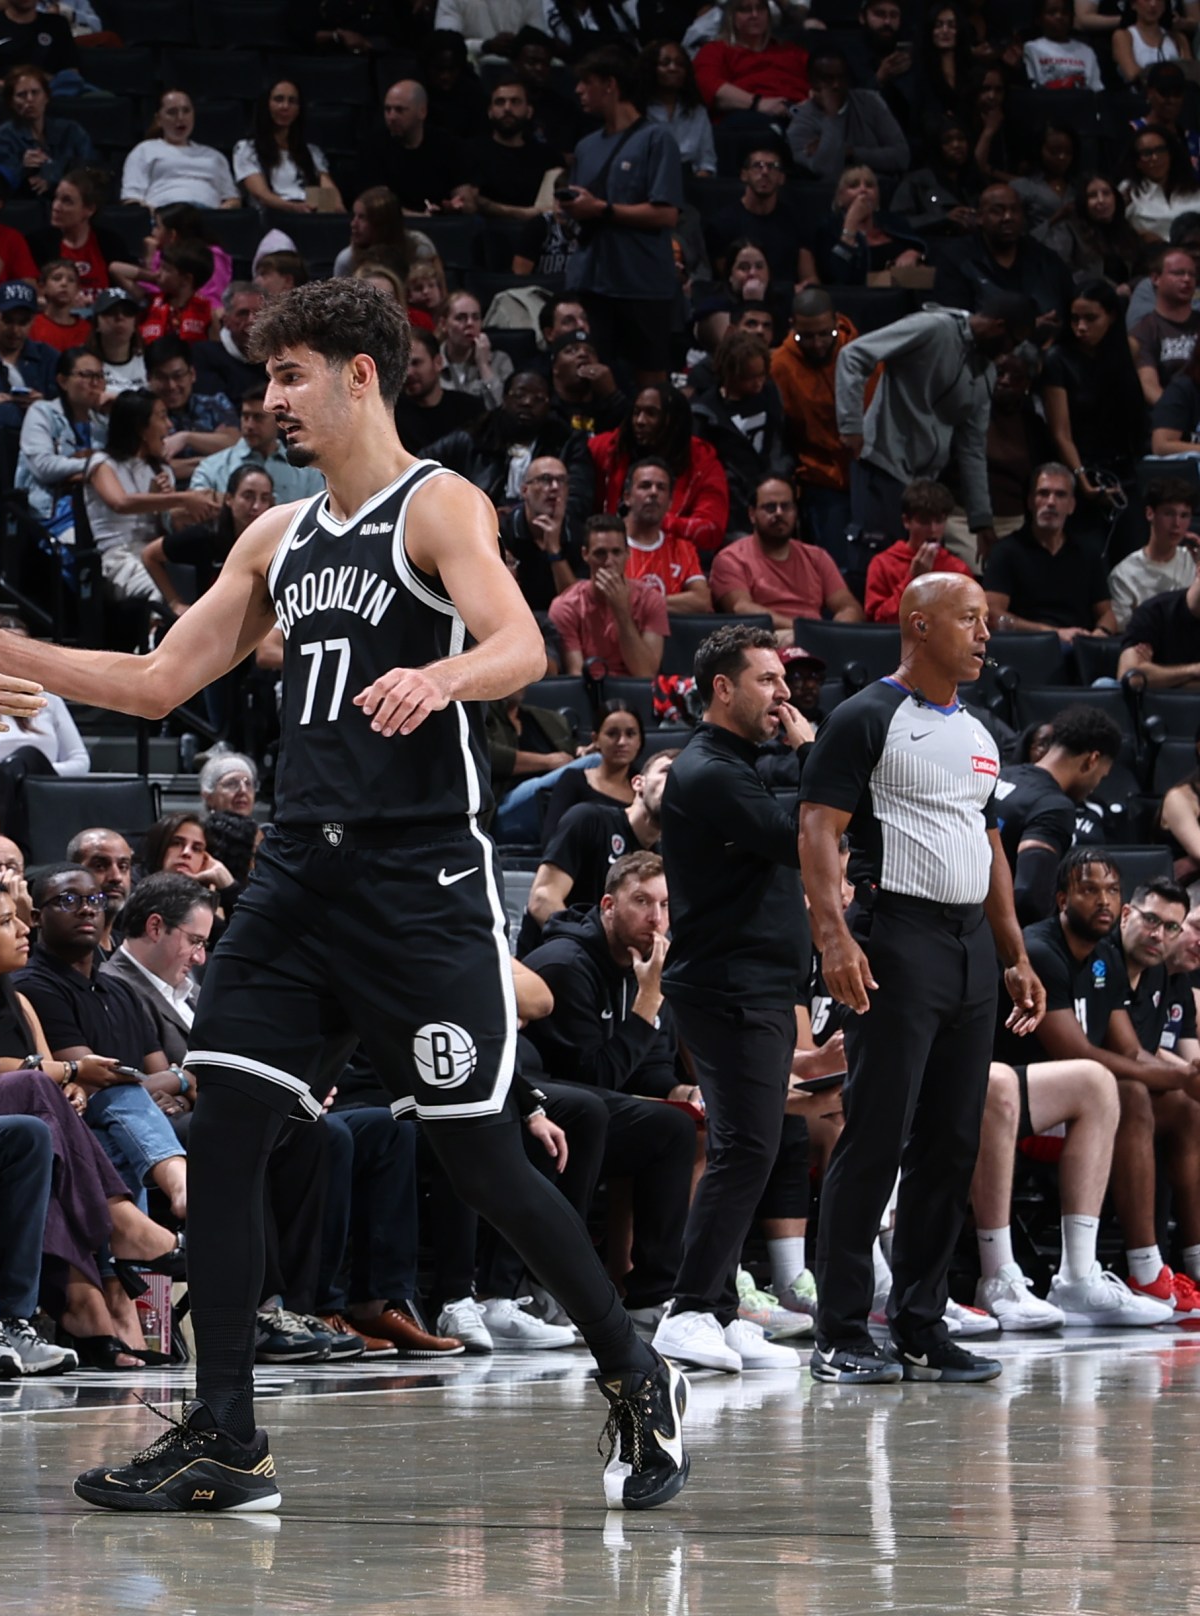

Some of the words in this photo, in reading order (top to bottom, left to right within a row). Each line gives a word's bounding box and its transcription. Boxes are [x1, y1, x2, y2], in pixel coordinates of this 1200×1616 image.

[359, 523, 371, 535] All
[275, 565, 397, 640] BROOKLYN
[299, 637, 351, 725] 77
[1075, 817, 1094, 834] YN
[431, 1032, 455, 1080] B
